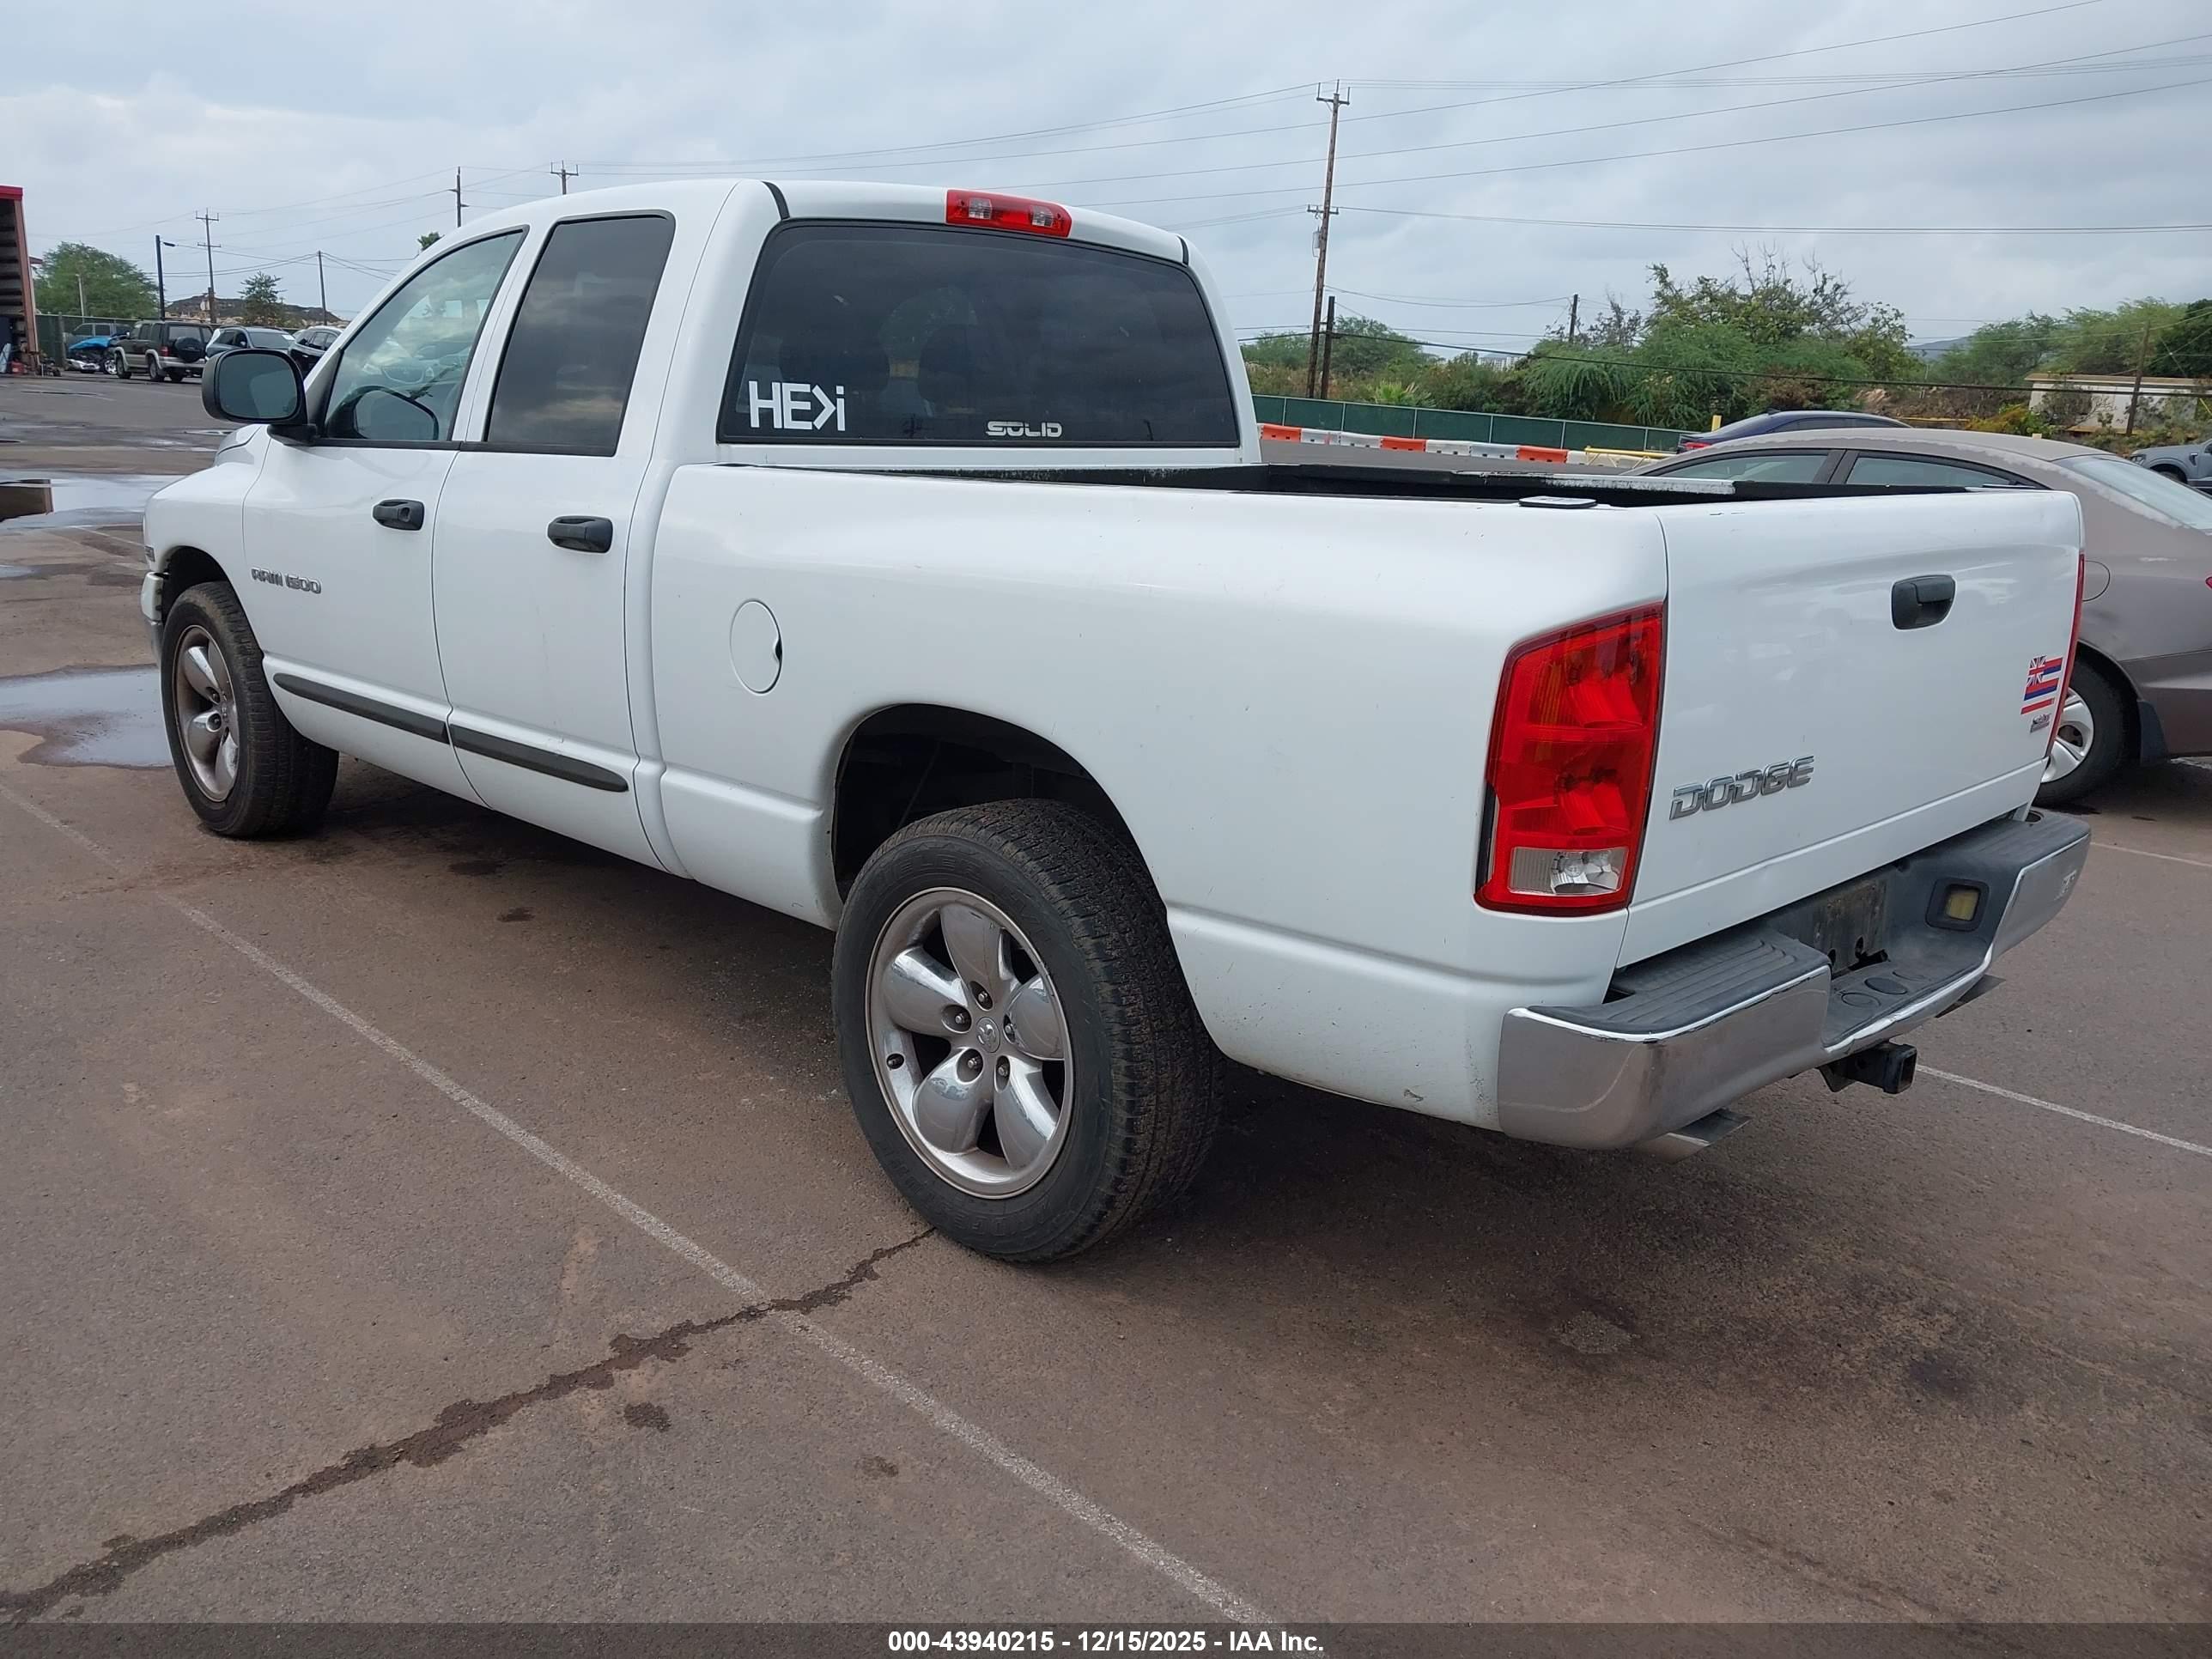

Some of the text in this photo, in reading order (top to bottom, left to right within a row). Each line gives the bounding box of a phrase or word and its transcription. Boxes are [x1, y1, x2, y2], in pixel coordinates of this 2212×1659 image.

[985, 420, 1063, 437] SOLID
[251, 567, 322, 595] RAM 1500
[1668, 755, 1814, 821] DODGE
